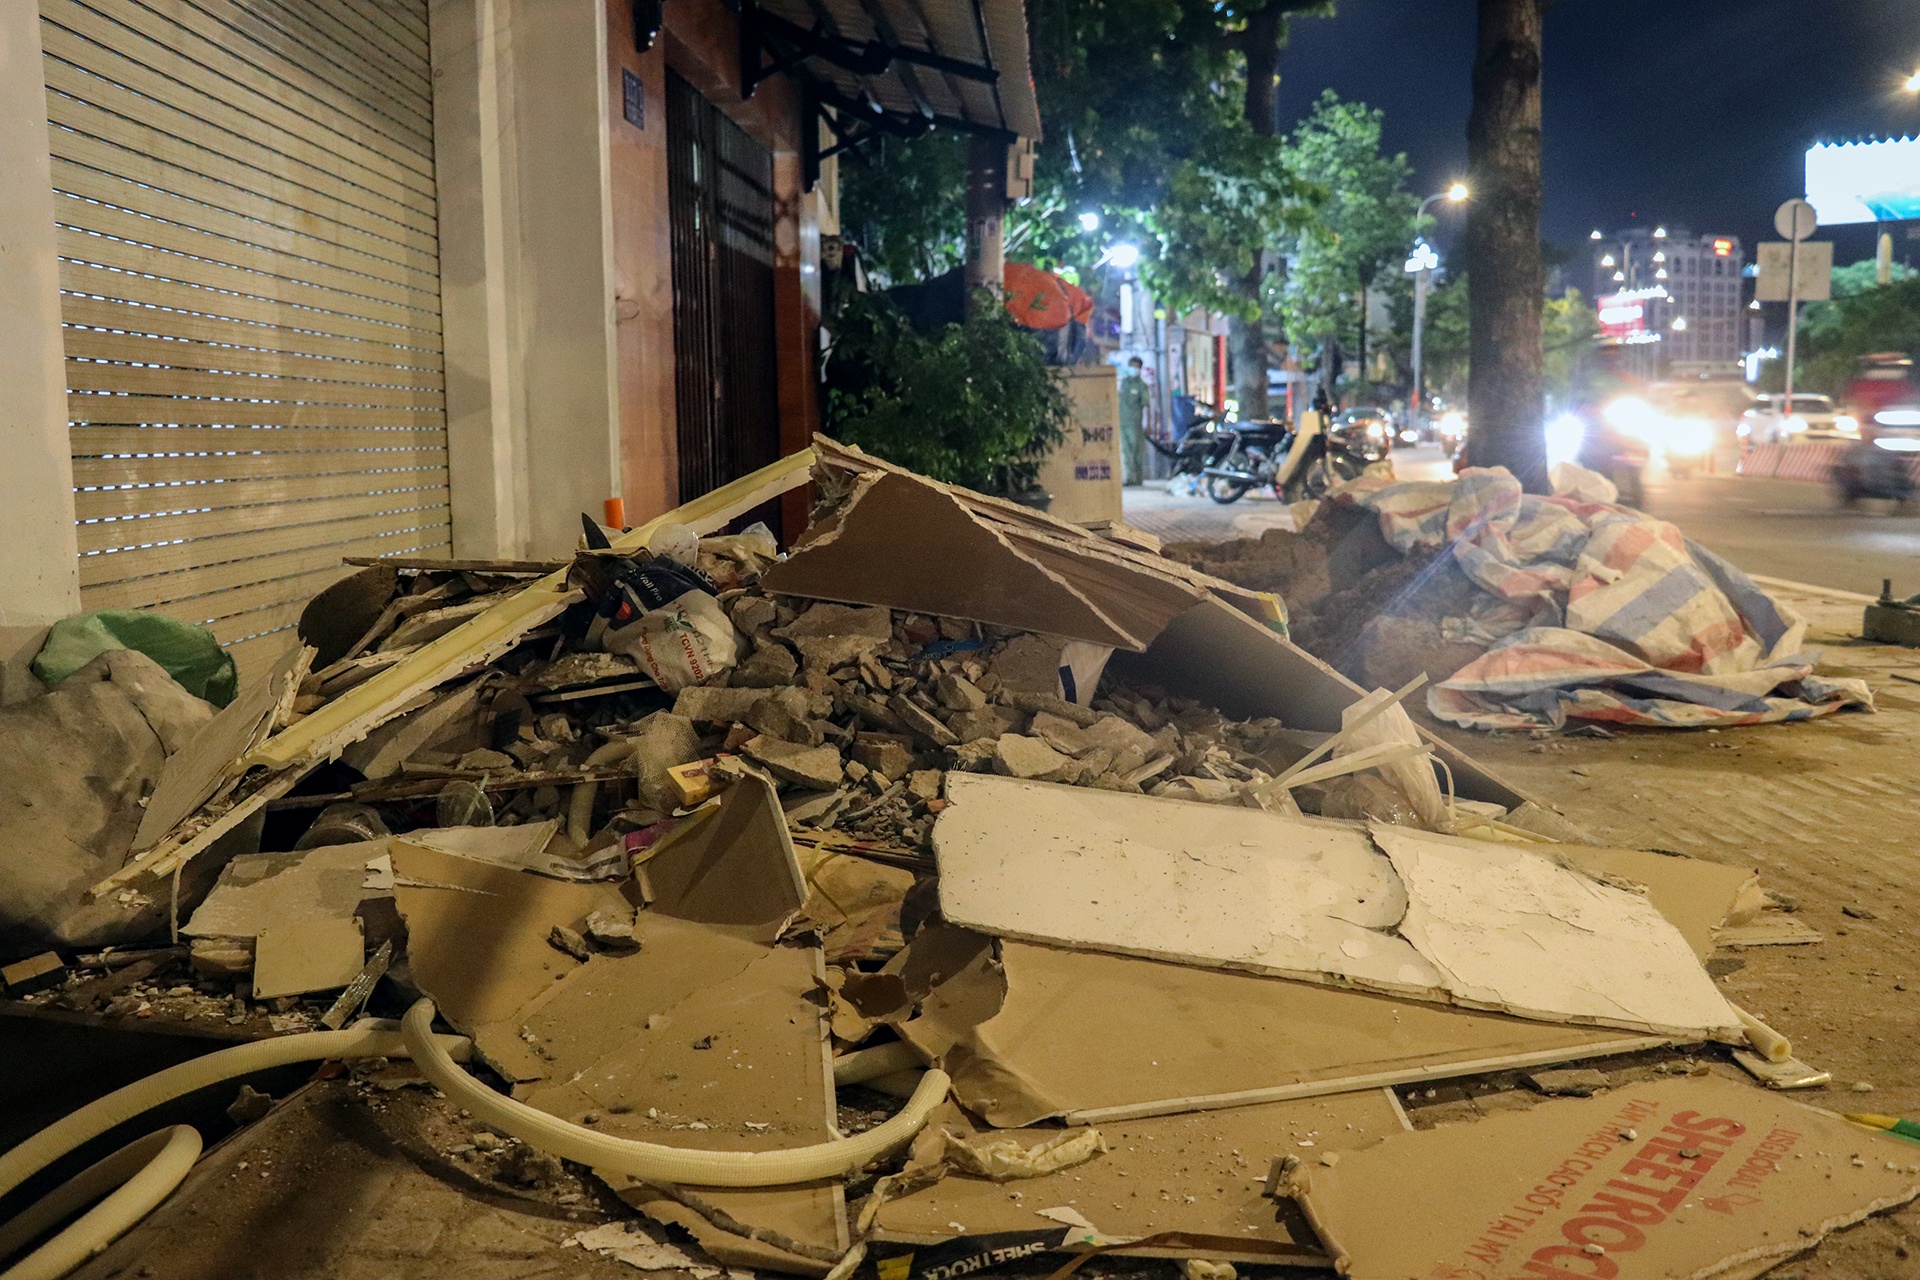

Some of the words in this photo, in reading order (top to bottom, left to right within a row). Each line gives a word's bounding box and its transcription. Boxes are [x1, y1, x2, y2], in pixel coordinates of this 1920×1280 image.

[650, 587, 663, 601] Pro
[680, 632, 695, 659] TCVN
[1546, 1158, 1594, 1186] CAO
[1524, 1185, 1565, 1209] SỐ
[1487, 1215, 1536, 1240] TẠI
